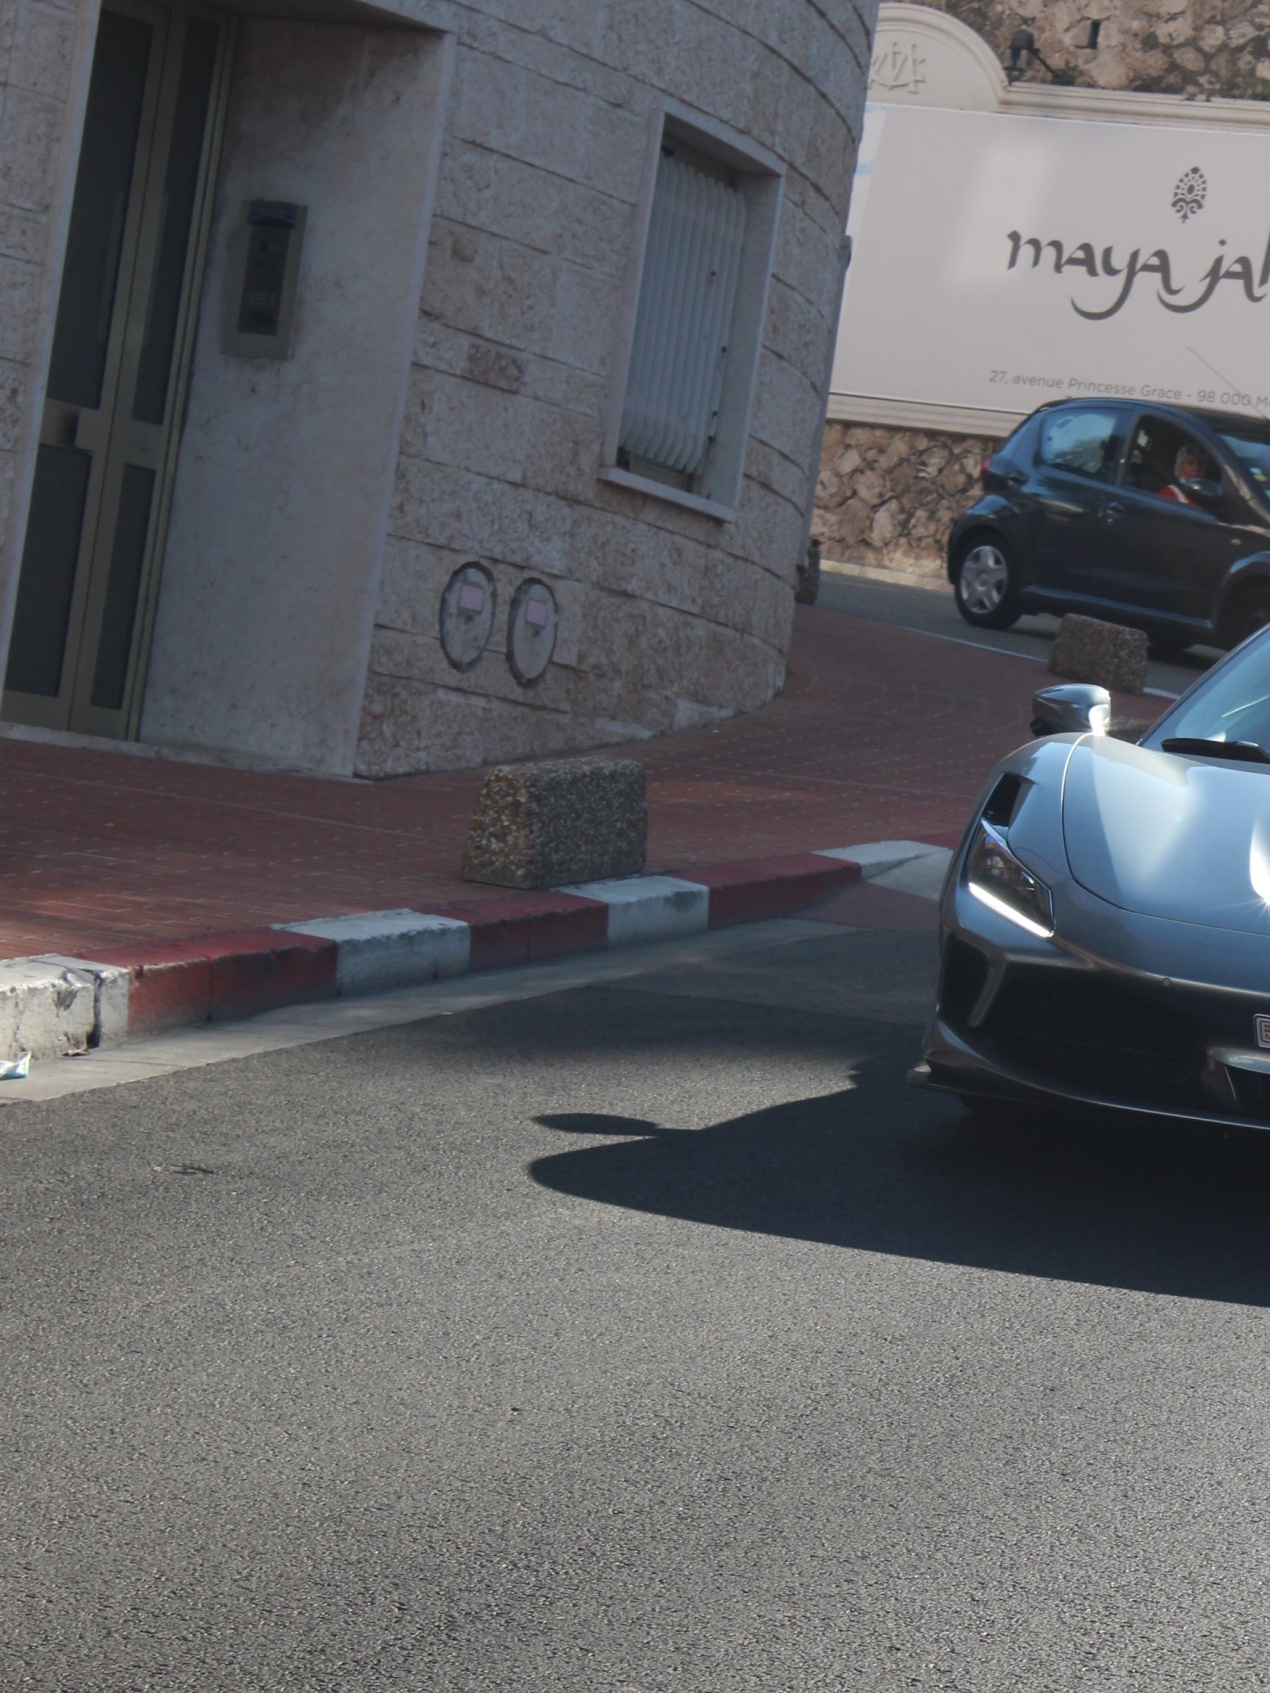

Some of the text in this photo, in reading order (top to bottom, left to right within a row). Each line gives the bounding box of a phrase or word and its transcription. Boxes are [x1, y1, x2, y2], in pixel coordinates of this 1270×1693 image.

[989, 370, 1008, 385] 27,
[1012, 374, 1064, 389] avenue
[1067, 378, 1136, 396] Princesse
[1140, 384, 1183, 400] Grace
[1197, 389, 1216, 403] 98
[1220, 392, 1250, 406] 000
